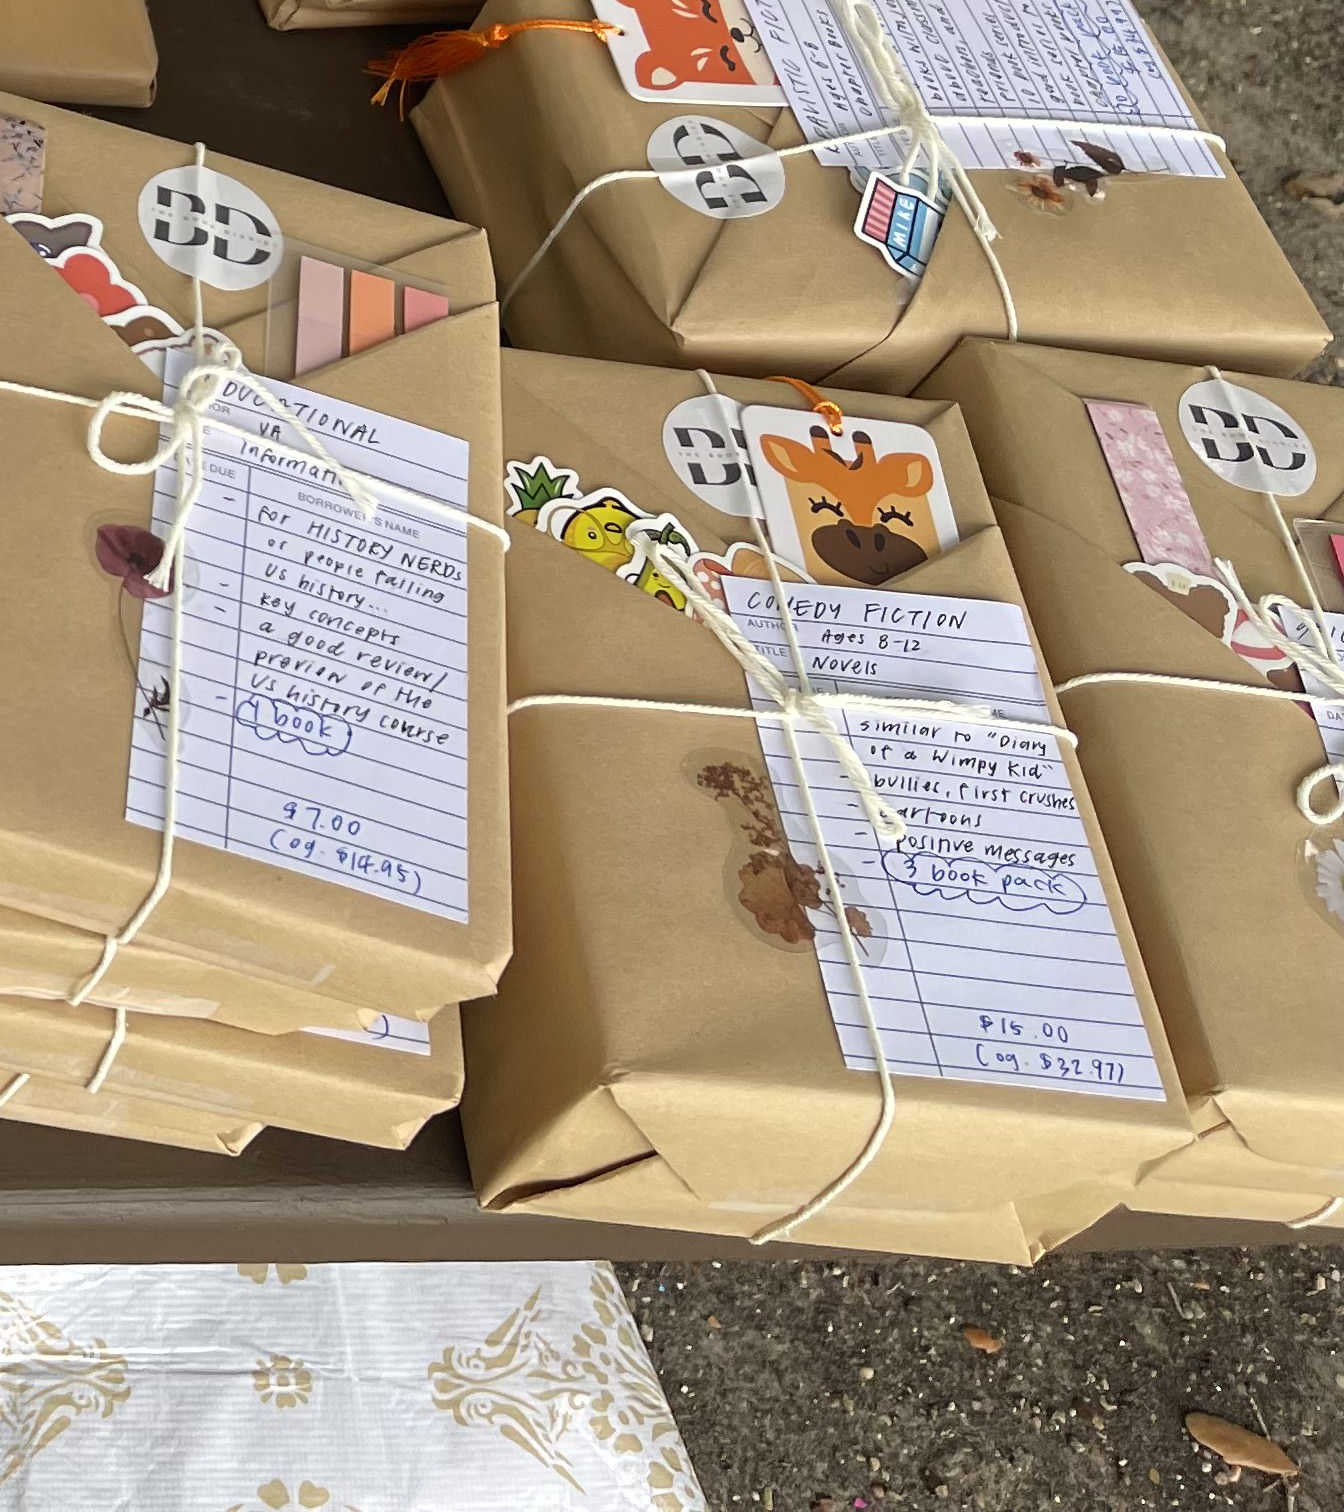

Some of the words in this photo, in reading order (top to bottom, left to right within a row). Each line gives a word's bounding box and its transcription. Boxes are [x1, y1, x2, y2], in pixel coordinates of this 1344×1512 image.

[822, 76, 849, 112] Ages
[154, 185, 272, 265] BD
[1188, 404, 1306, 470] BD
[210, 463, 236, 479] DUE
[307, 521, 393, 560] HISTORY
[385, 520, 420, 538] NAME
[268, 539, 287, 550] or
[304, 550, 364, 579] people
[310, 609, 400, 646] concepts
[864, 604, 968, 629] FICTION
[259, 621, 274, 633] a
[287, 631, 345, 657] good
[822, 629, 865, 645] Ages
[879, 635, 921, 652] 8-12
[812, 656, 878, 675] Novels
[361, 680, 386, 696] of
[396, 687, 433, 709] the
[273, 704, 334, 738] book
[286, 684, 371, 723] history
[379, 714, 450, 746] course
[860, 720, 942, 738] similar
[954, 731, 971, 743] to
[871, 745, 892, 760] of
[905, 752, 917, 760] a
[933, 750, 998, 776] Wimpy
[874, 774, 950, 798] bullies,
[960, 783, 1011, 803] first
[1020, 791, 1076, 810] crushes
[896, 834, 974, 853] positive
[985, 843, 1076, 868] messages
[904, 858, 917, 878] 3
[932, 865, 987, 885] book
[1002, 875, 1066, 896] pack
